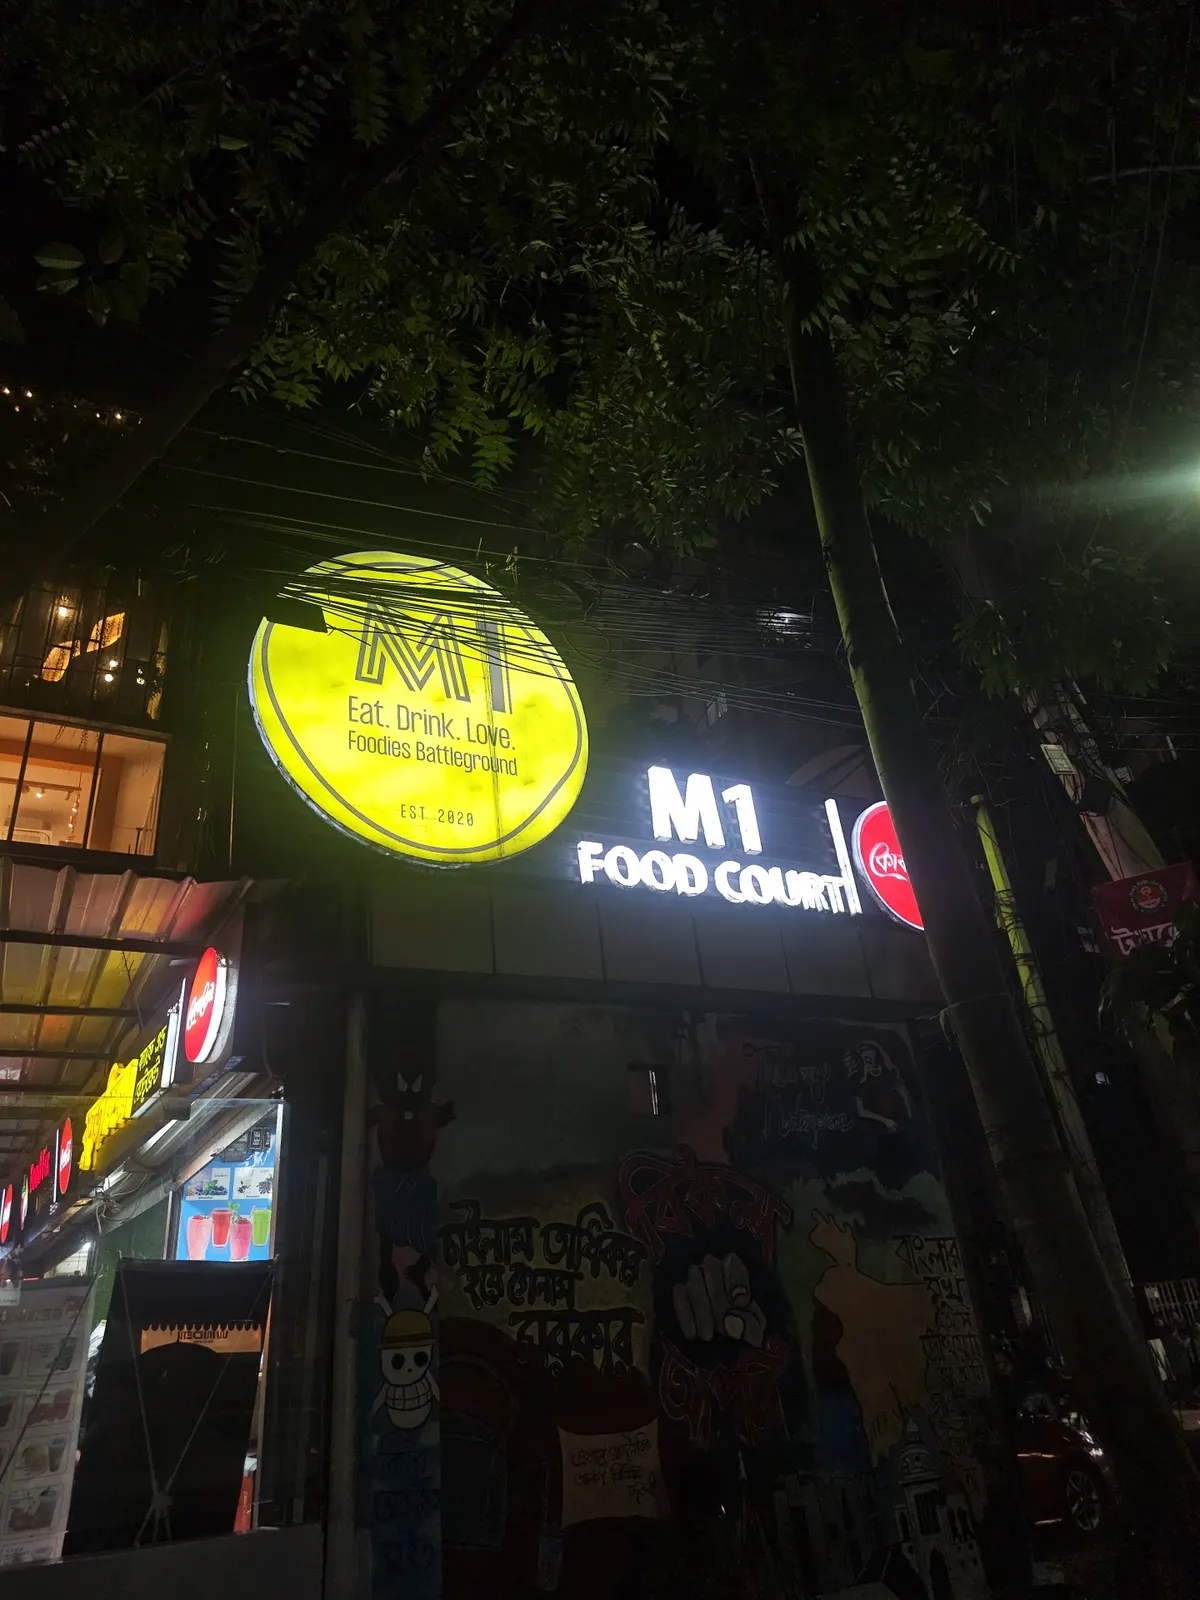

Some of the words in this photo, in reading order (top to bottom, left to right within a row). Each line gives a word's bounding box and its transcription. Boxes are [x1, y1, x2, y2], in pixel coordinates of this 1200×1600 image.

[348, 696, 390, 729] Eat.
[397, 704, 461, 740] Drink.
[467, 716, 516, 750] Love.
[348, 730, 411, 759] Foodies
[416, 741, 518, 777] Battleground
[401, 804, 425, 820] EST
[438, 808, 474, 826] 2020
[647, 766, 763, 856] M1
[577, 840, 708, 897] FOOD
[714, 861, 847, 914] COURT
